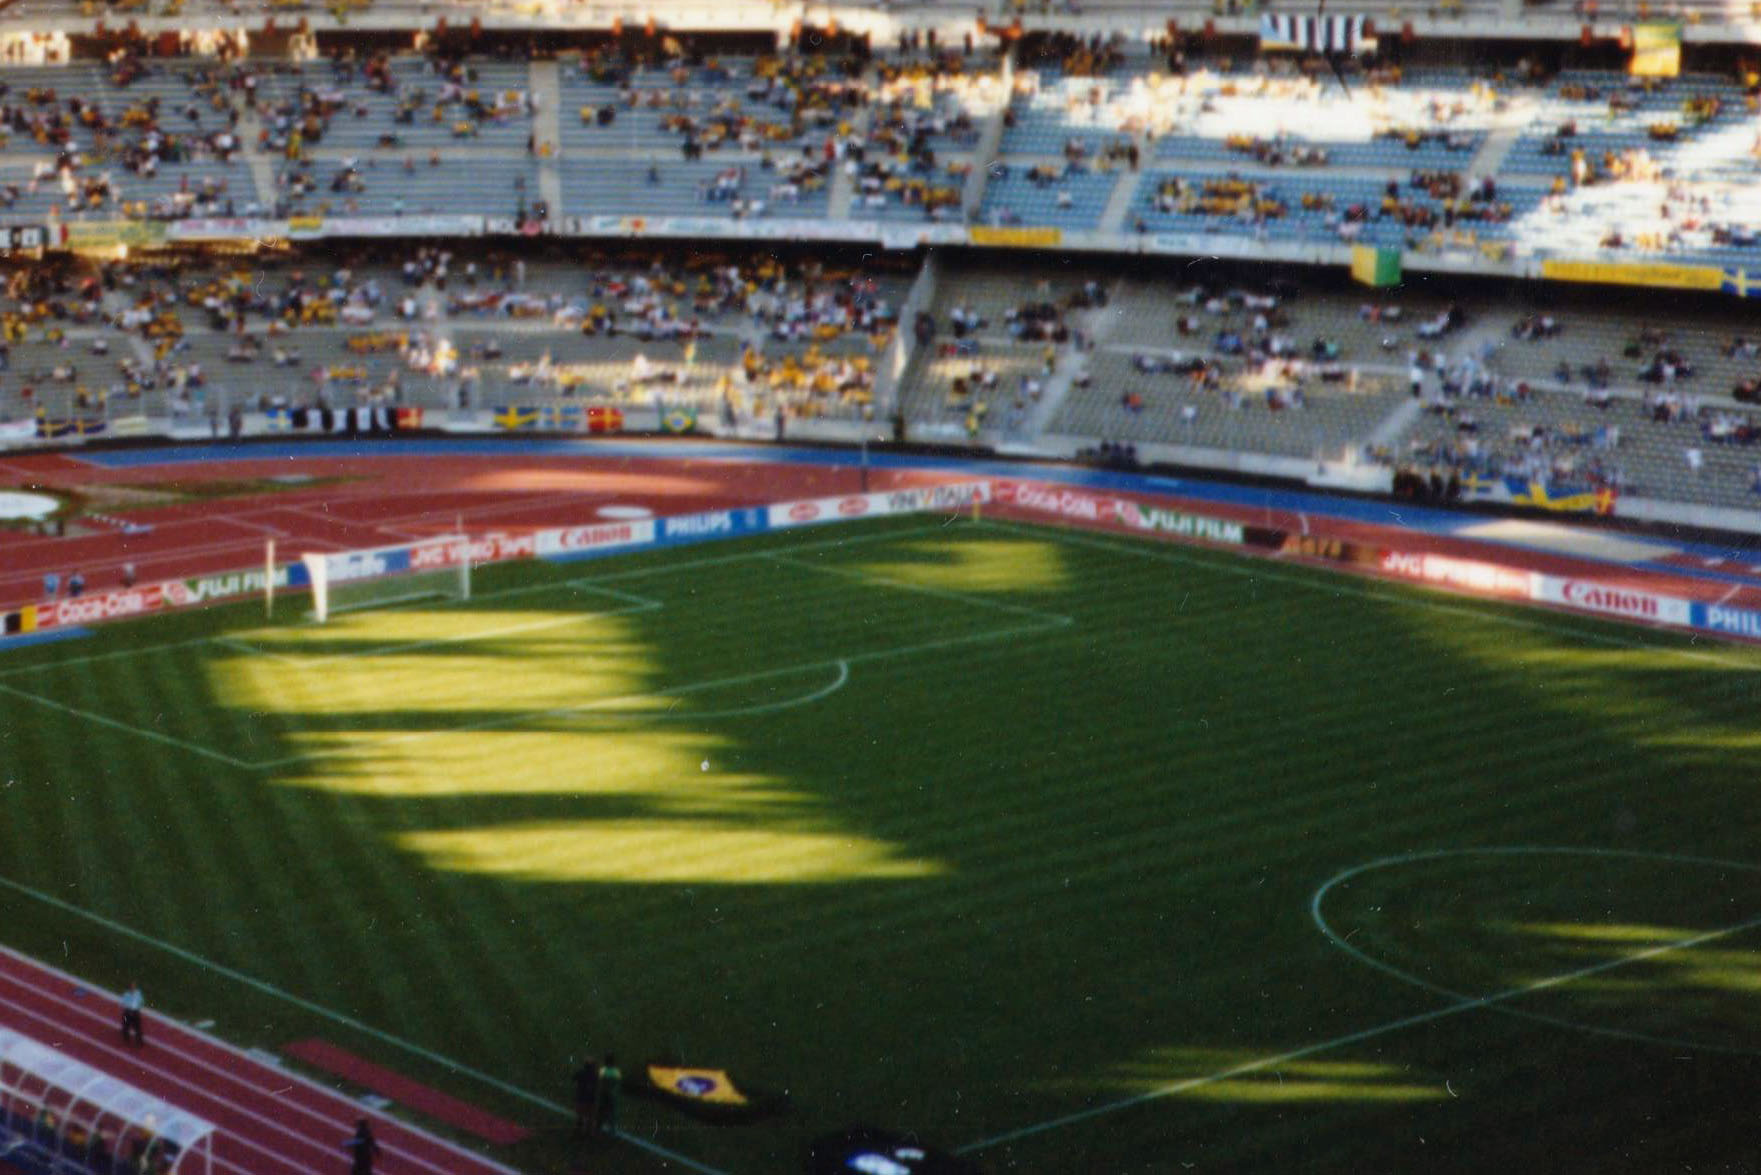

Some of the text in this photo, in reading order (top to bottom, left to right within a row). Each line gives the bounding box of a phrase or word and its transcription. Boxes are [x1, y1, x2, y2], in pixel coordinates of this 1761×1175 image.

[560, 525, 632, 549] Canon
[665, 511, 732, 537] PHILIPS
[1151, 509, 1243, 543] FUJI FILM
[1383, 551, 1422, 577] JVC
[197, 574, 240, 600] FUJI
[1561, 581, 1658, 616] Canon
[56, 592, 143, 623] Coca-Cola
